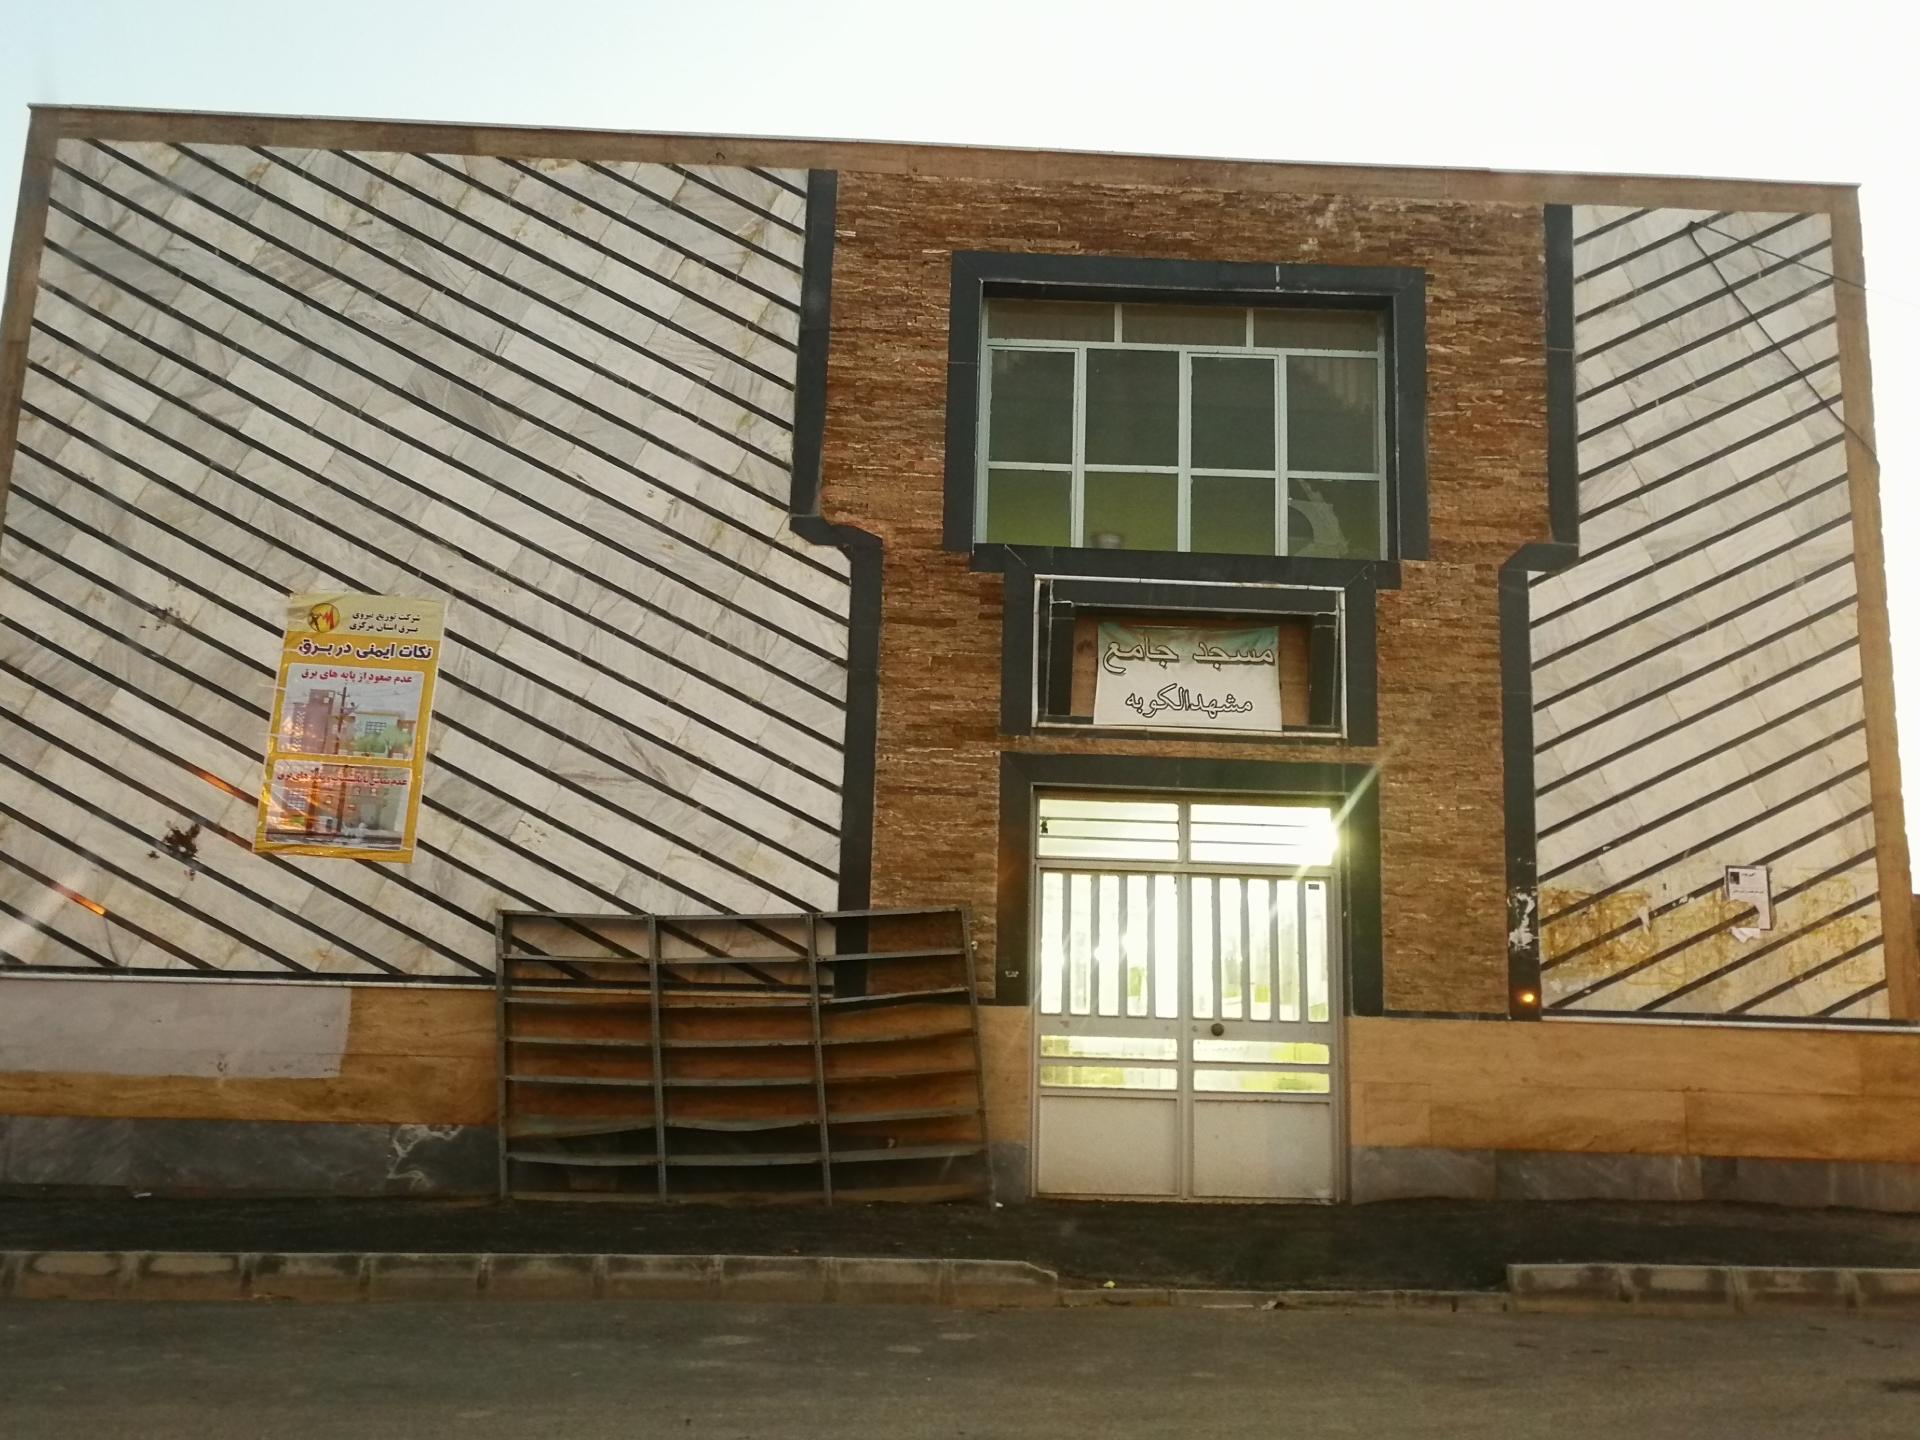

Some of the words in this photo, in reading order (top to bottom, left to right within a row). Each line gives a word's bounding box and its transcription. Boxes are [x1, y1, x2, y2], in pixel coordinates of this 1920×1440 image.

[352, 611, 374, 621] نیروی
[376, 612, 398, 622] توزیع
[398, 612, 421, 624] شرکت
[349, 621, 375, 632] مرکزی
[376, 623, 397, 632] استان
[299, 639, 332, 655] برق
[336, 643, 351, 657] در
[356, 643, 395, 660] ایمنی
[399, 644, 432, 659] نکات
[1102, 632, 1180, 676] جامع
[1192, 641, 1276, 672] مسجد
[301, 668, 318, 679] برق
[320, 669, 338, 680] های
[358, 671, 367, 682] از
[368, 673, 392, 684] صعود
[393, 675, 412, 684] عدم
